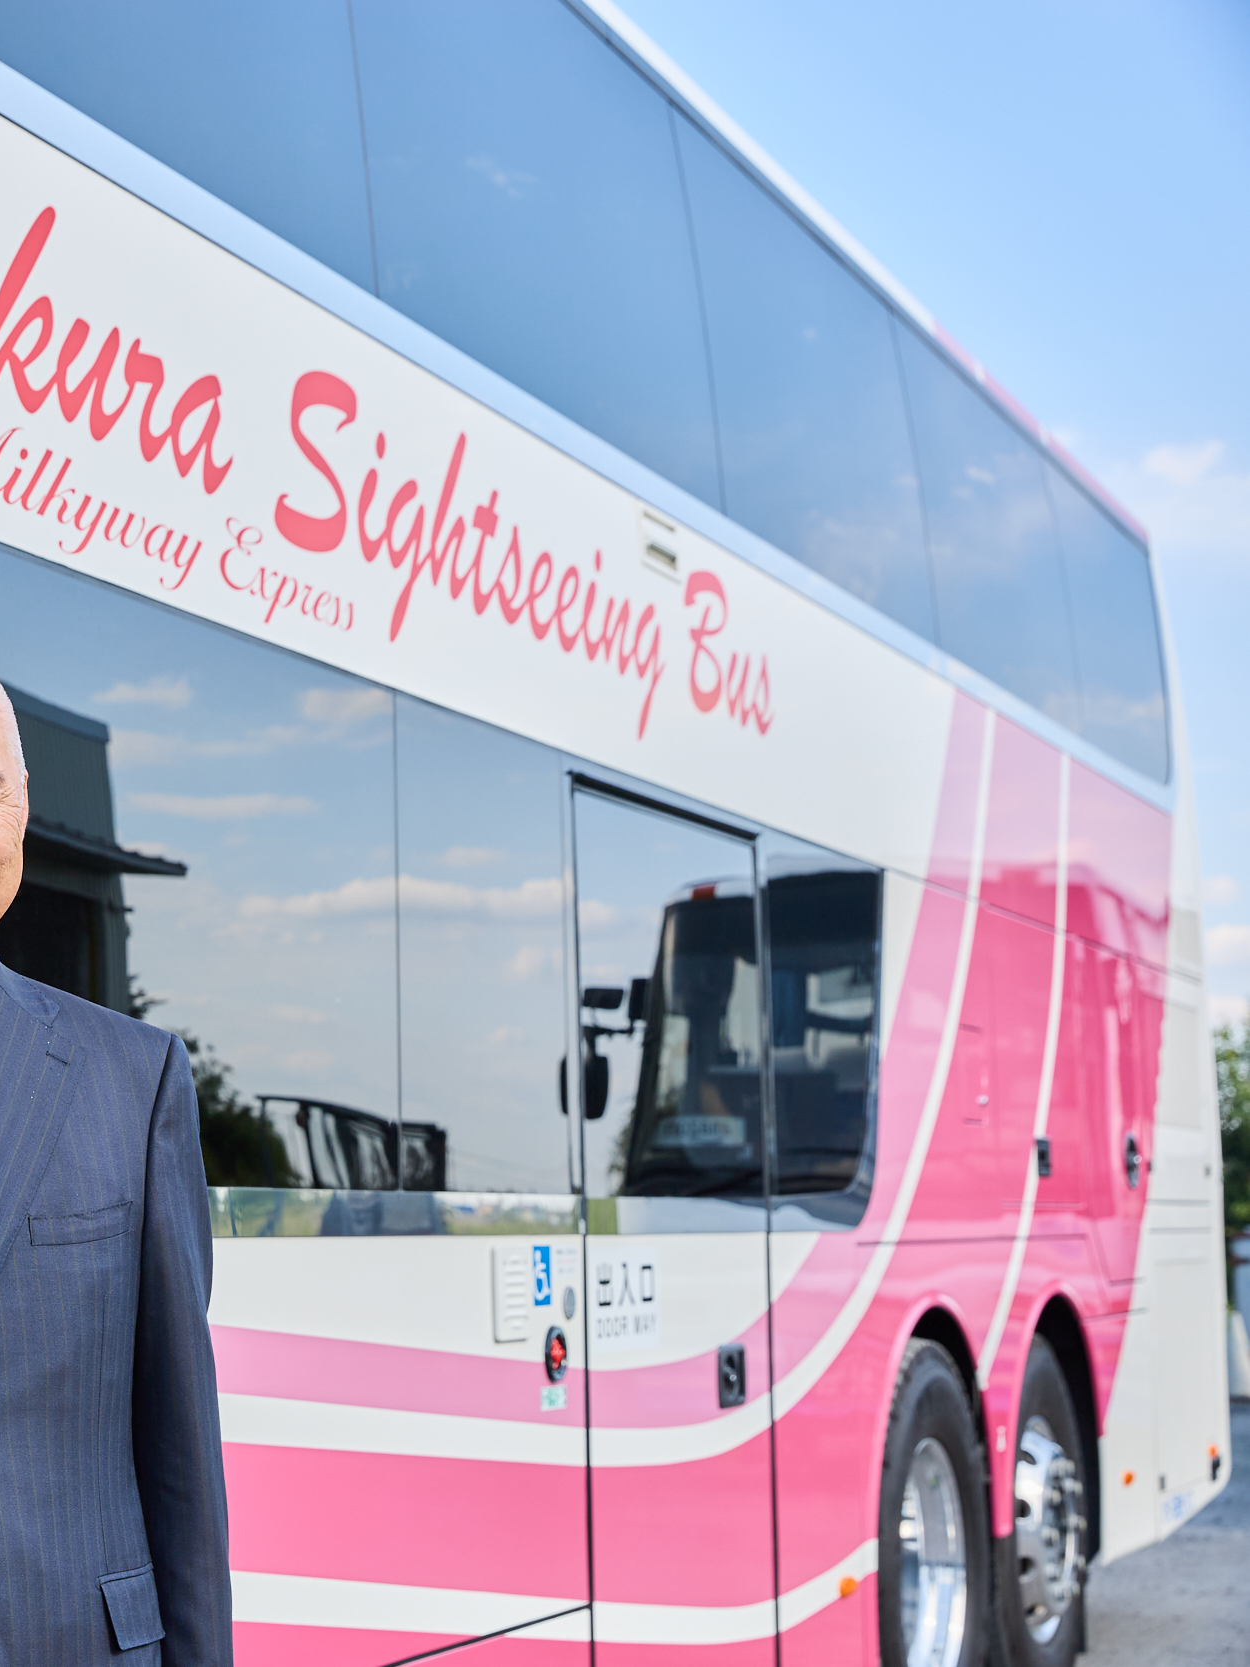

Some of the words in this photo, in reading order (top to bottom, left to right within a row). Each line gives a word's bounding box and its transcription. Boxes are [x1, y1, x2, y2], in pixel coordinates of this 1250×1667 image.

[219, 517, 355, 632] Express
[273, 370, 664, 741] Sightseeing
[683, 570, 773, 737] Bus
[596, 1261, 655, 1307] 出入口
